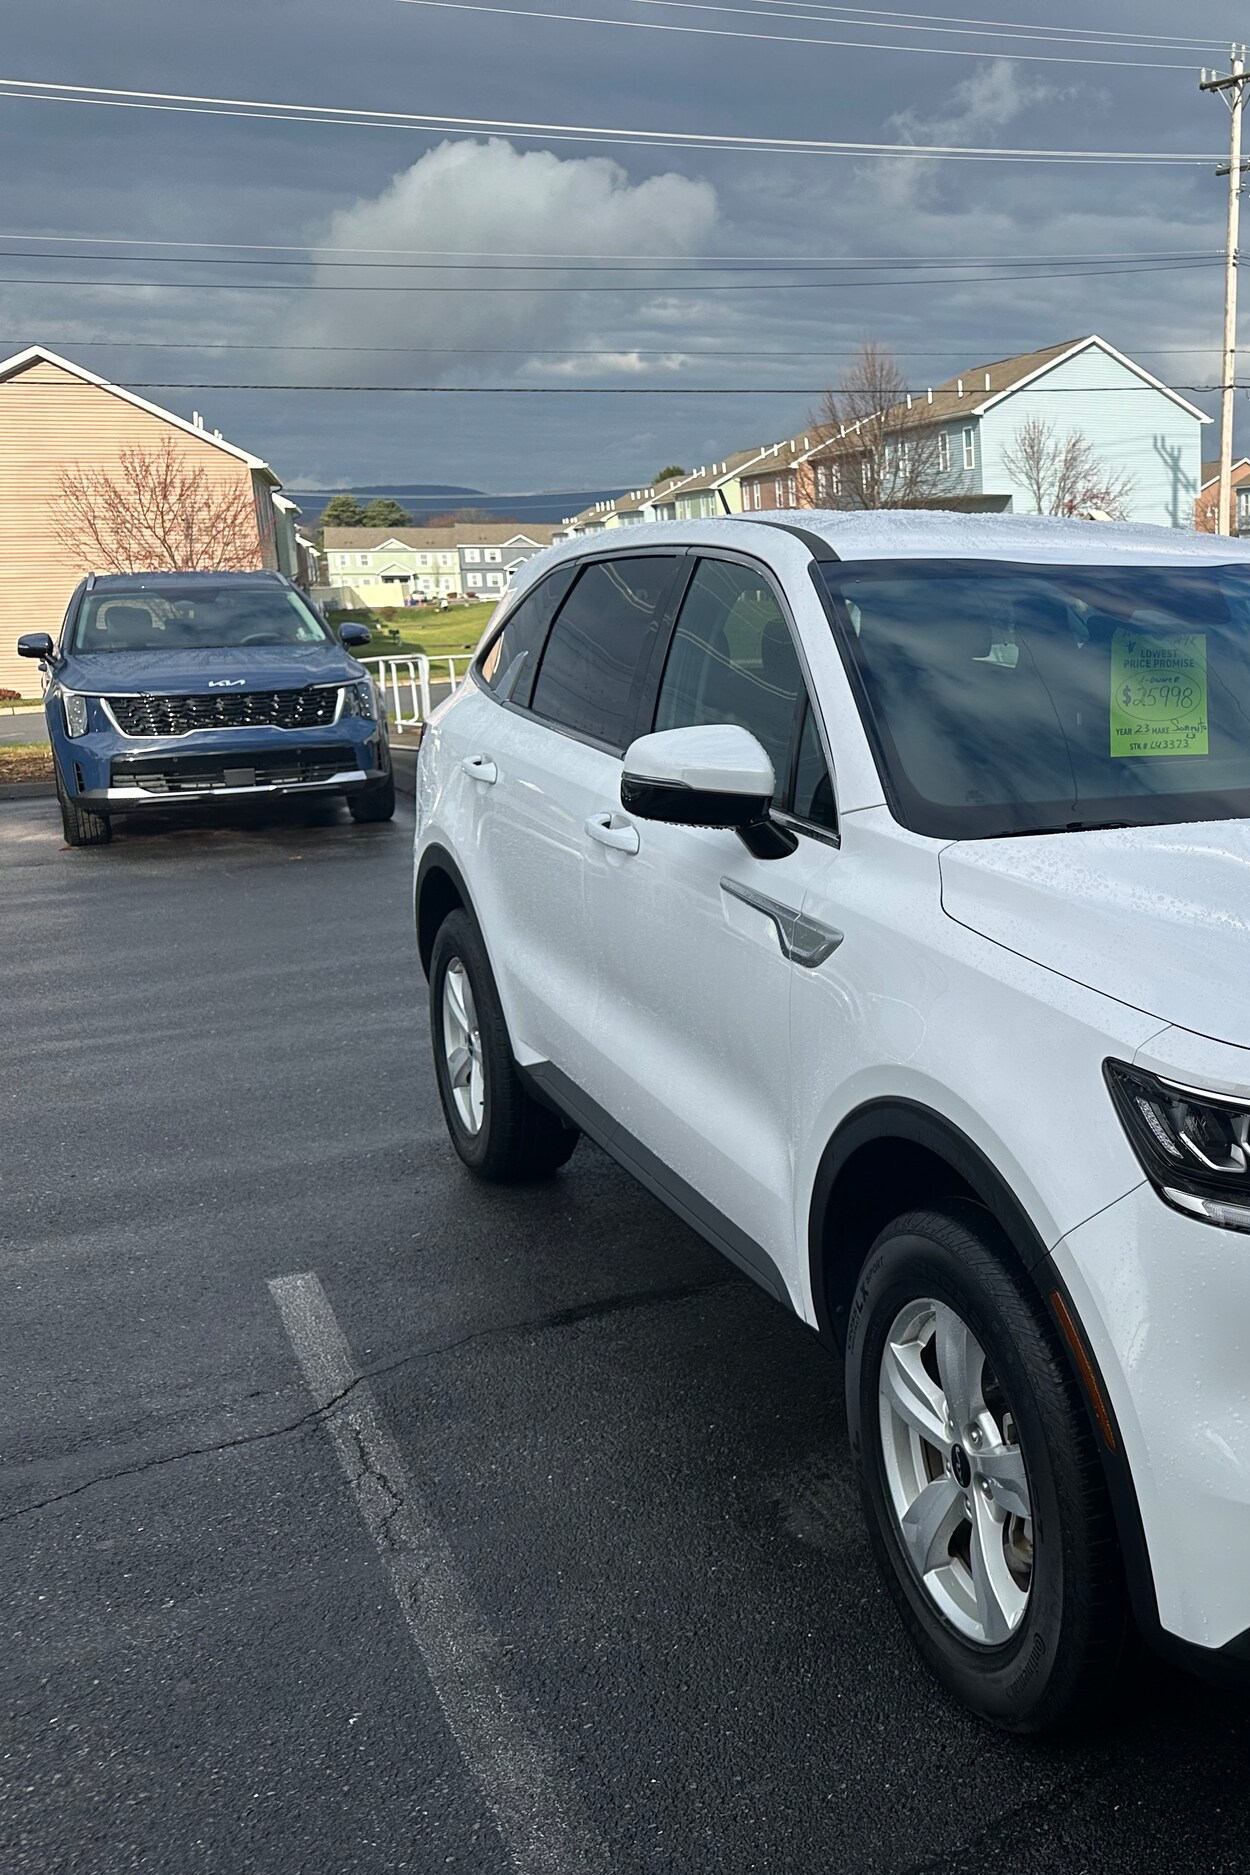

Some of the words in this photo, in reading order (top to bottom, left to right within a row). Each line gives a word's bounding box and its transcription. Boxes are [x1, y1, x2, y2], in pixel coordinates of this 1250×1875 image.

[1141, 649, 1177, 659] LOWEST
[1124, 659, 1150, 668] PRICE
[1154, 658, 1195, 668] PROMISE
[208, 679, 246, 687] KIA
[1115, 727, 1132, 735] YEAR
[1135, 724, 1150, 733] 23
[865, 1256, 884, 1284] SPORT
